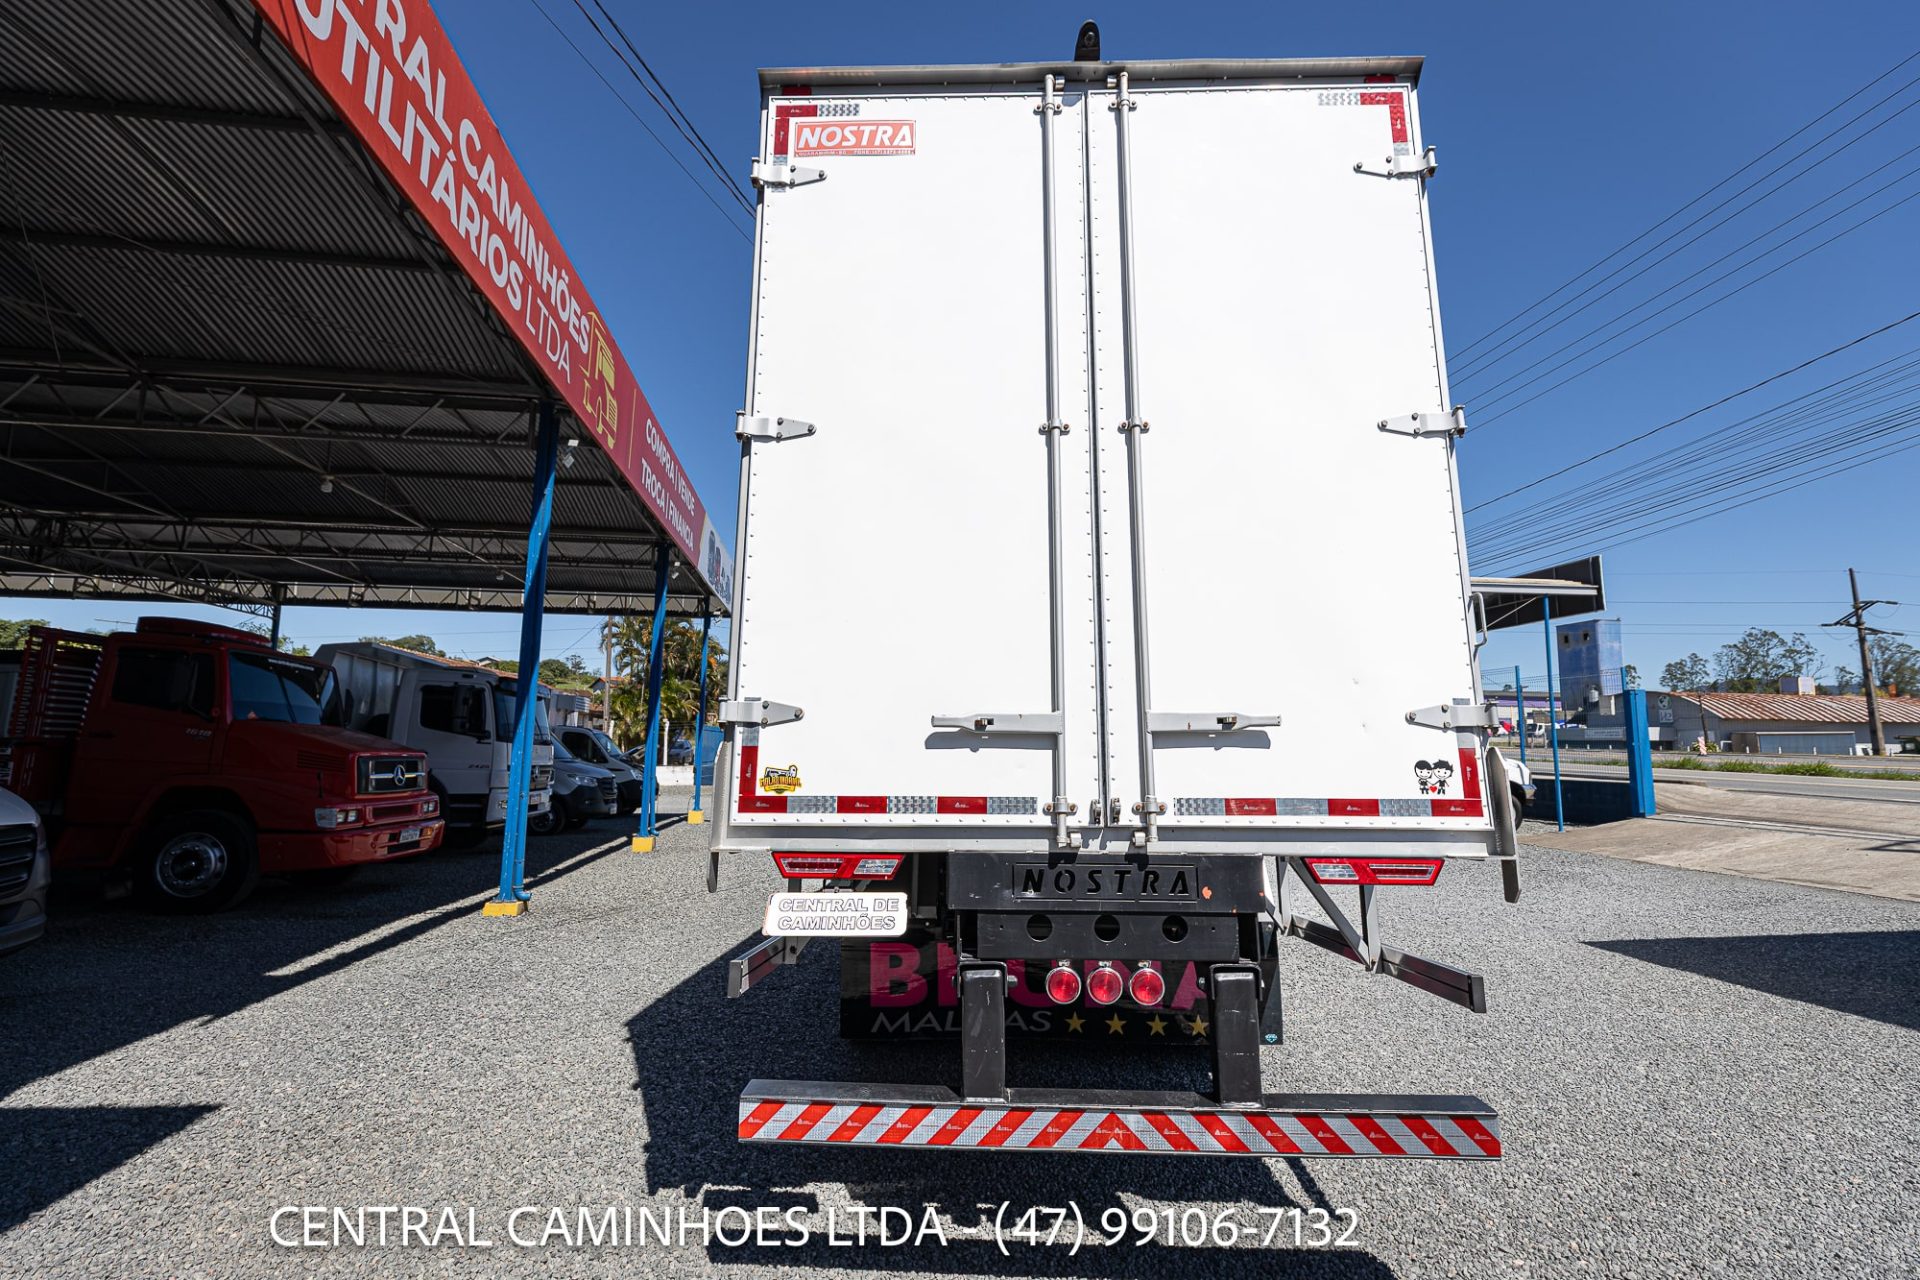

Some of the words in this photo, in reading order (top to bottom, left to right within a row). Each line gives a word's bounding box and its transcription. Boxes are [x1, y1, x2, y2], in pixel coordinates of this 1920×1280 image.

[797, 125, 913, 149] NOSTRA
[358, 0, 453, 144] RAL
[459, 118, 590, 354] CAMINHÕES
[526, 284, 571, 384] LTDA
[646, 418, 675, 485] COMPRA
[677, 471, 695, 516] VENDE
[641, 457, 665, 508] TROCA
[668, 501, 693, 551] FINANCIA
[1022, 868, 1190, 895] NOSTRA
[778, 898, 869, 912] CENTRAL
[873, 898, 900, 912] DE
[777, 913, 896, 931] CAMINHÕES
[870, 1010, 1053, 1034] MALAS
